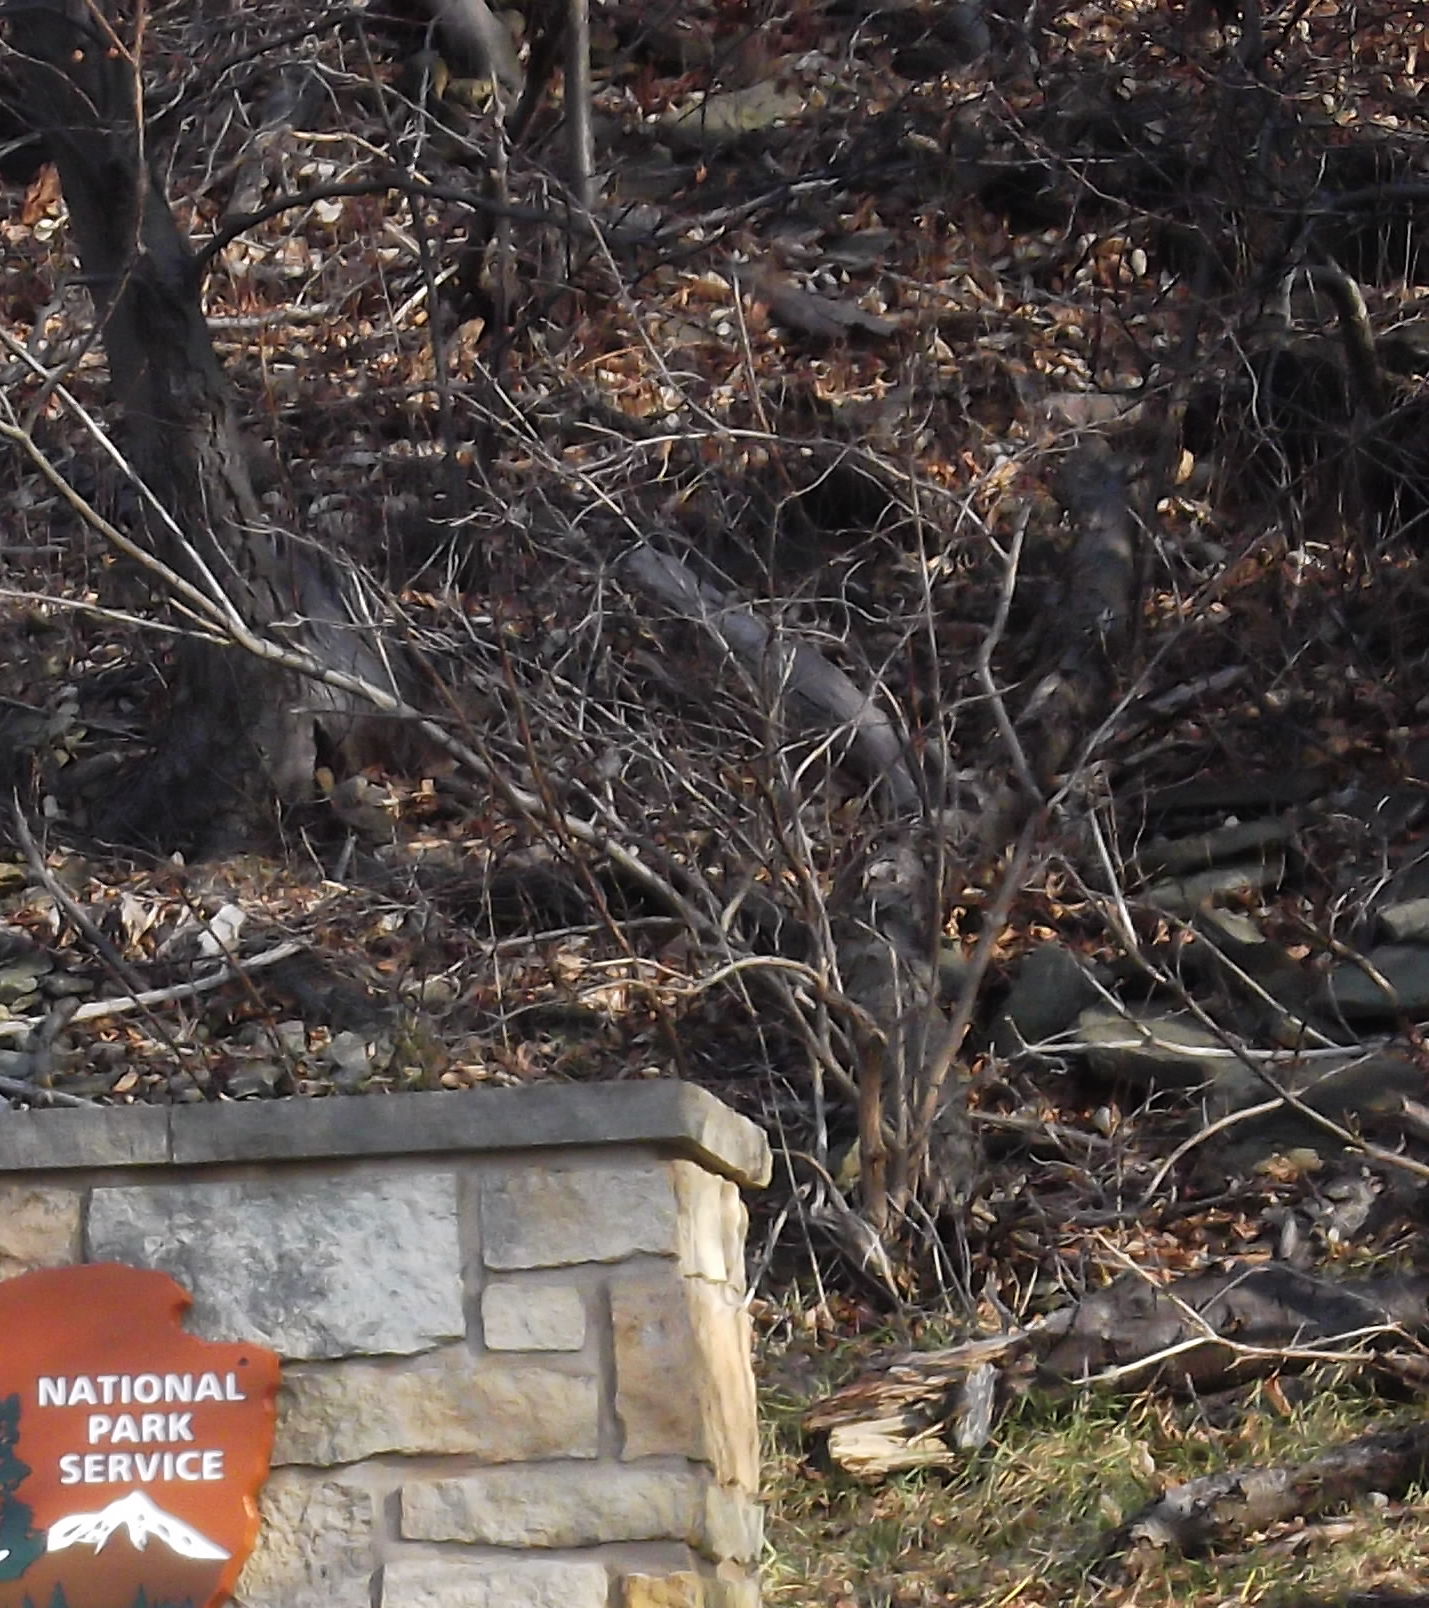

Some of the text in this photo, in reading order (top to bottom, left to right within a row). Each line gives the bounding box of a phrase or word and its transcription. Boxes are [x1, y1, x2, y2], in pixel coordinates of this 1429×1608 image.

[37, 1372, 246, 1406] NATIONAL
[87, 1412, 194, 1444] PARK
[59, 1449, 225, 1484] SERVICE
